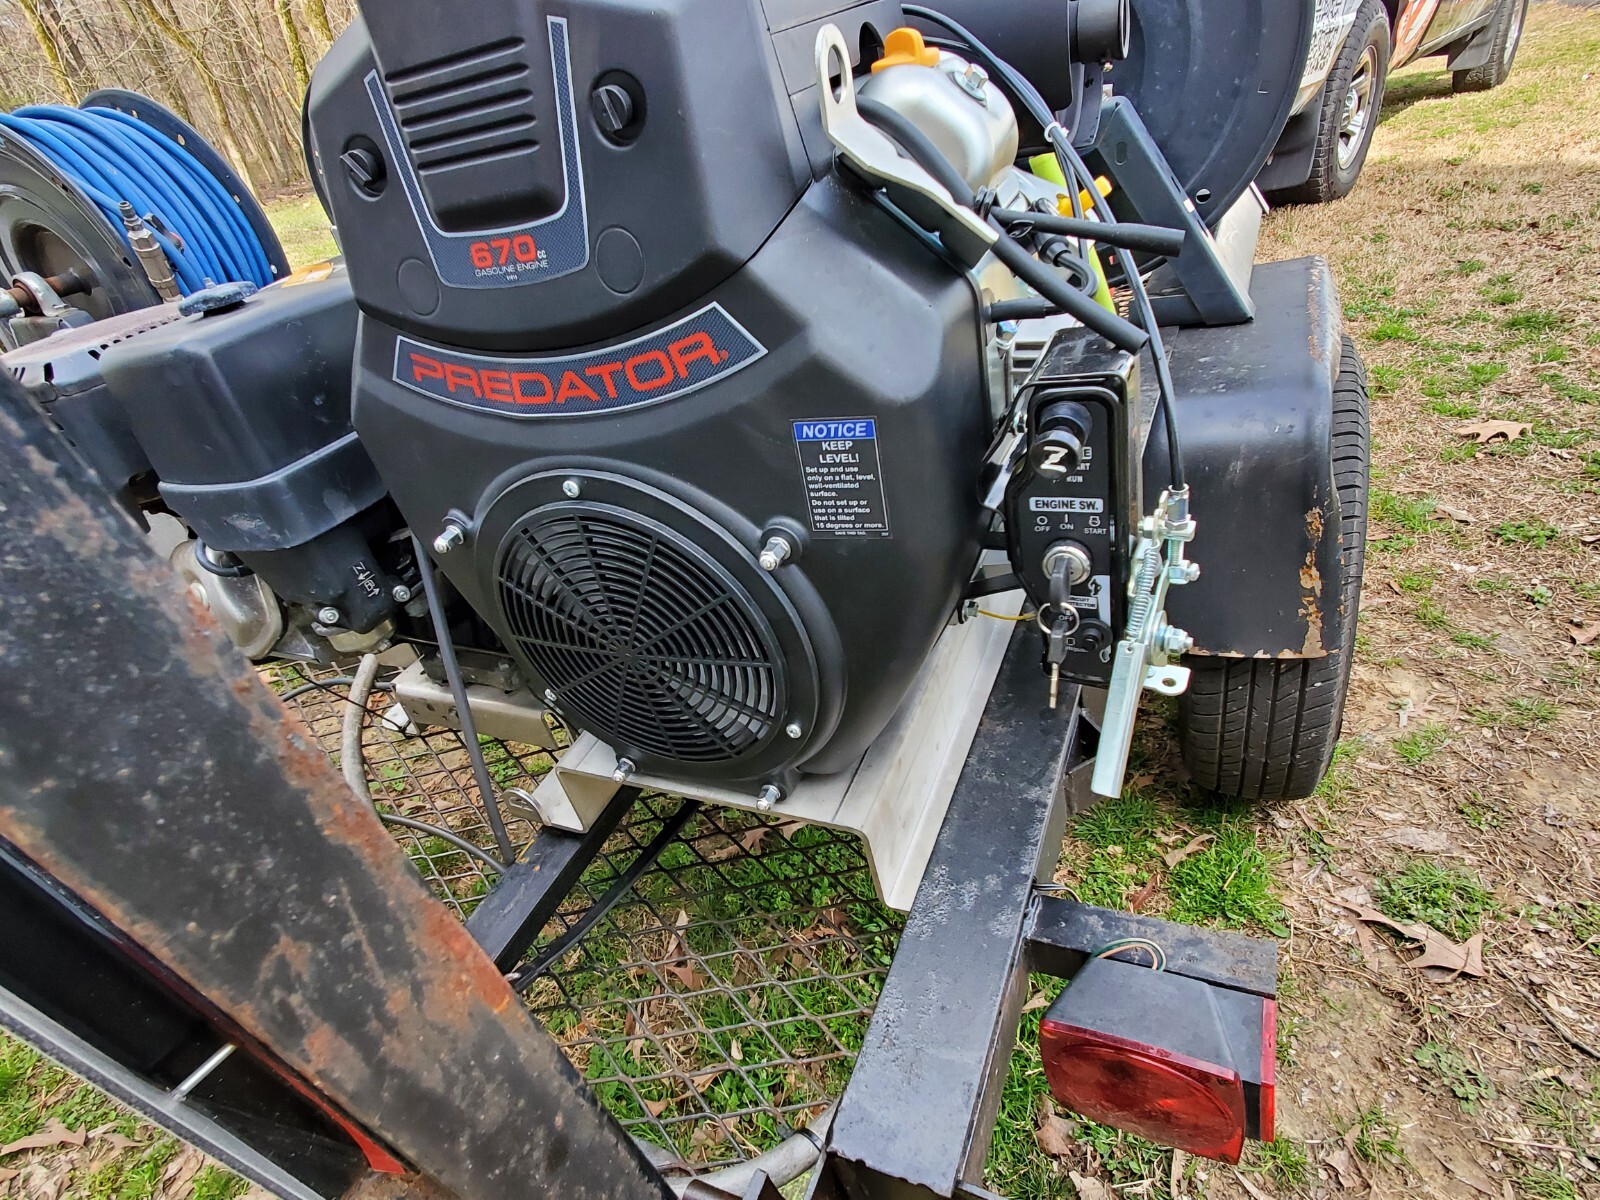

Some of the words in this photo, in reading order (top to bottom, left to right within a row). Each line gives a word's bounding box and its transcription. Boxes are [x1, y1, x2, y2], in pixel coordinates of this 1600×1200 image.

[470, 234, 537, 268] 670
[475, 264, 515, 277] GASOLINE
[517, 259, 549, 272] ENGINE
[409, 331, 721, 405] PREDATOR
[802, 422, 867, 438] NOTICE
[822, 440, 853, 451] KEEP
[819, 453, 860, 464] LEVEL!
[807, 474, 822, 482] only
[1035, 499, 1076, 509] ENGINE
[1078, 500, 1099, 511] SW.
[1084, 527, 1108, 535] START
